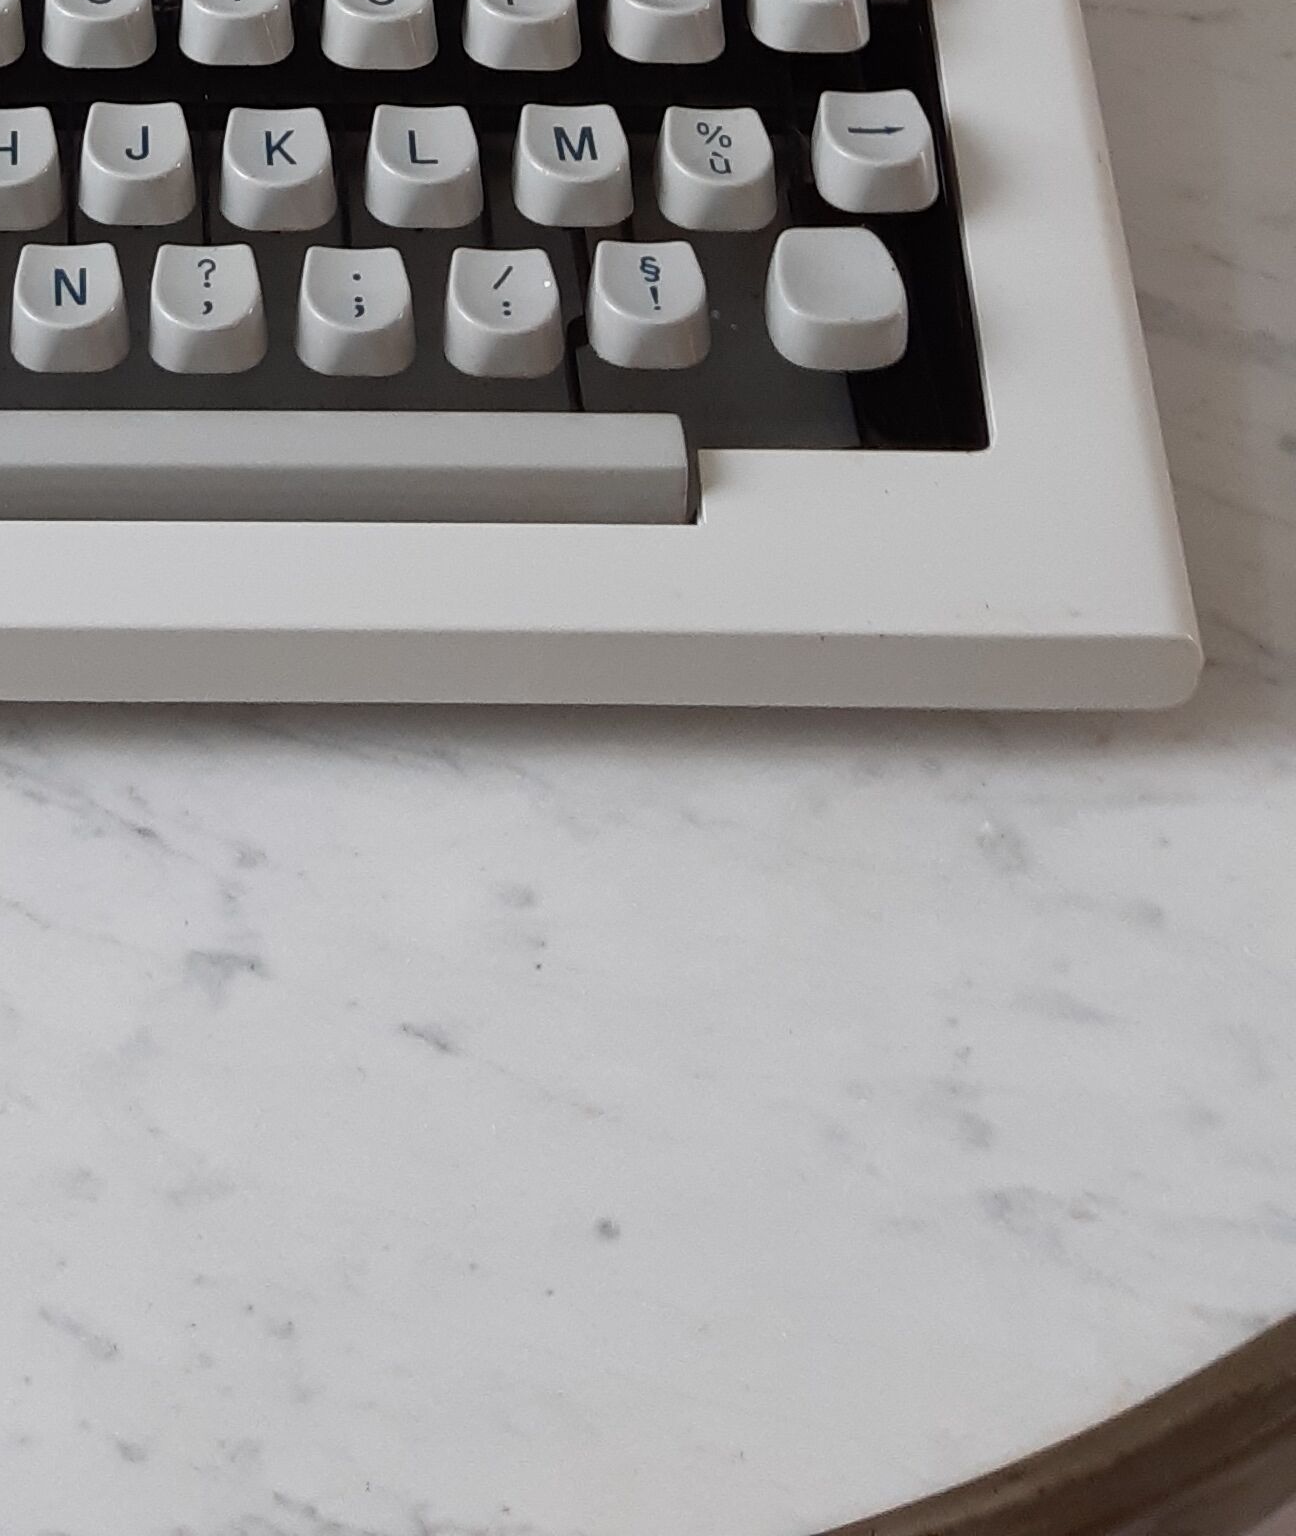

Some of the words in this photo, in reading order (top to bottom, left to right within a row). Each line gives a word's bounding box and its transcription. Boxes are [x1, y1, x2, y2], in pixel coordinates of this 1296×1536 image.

[125, 125, 150, 161] J
[264, 130, 297, 167] K
[407, 129, 439, 165] L
[553, 126, 598, 162] M
[696, 121, 733, 149] %
[708, 151, 732, 175] ù
[54, 267, 87, 307] N
[197, 258, 217, 289] ?
